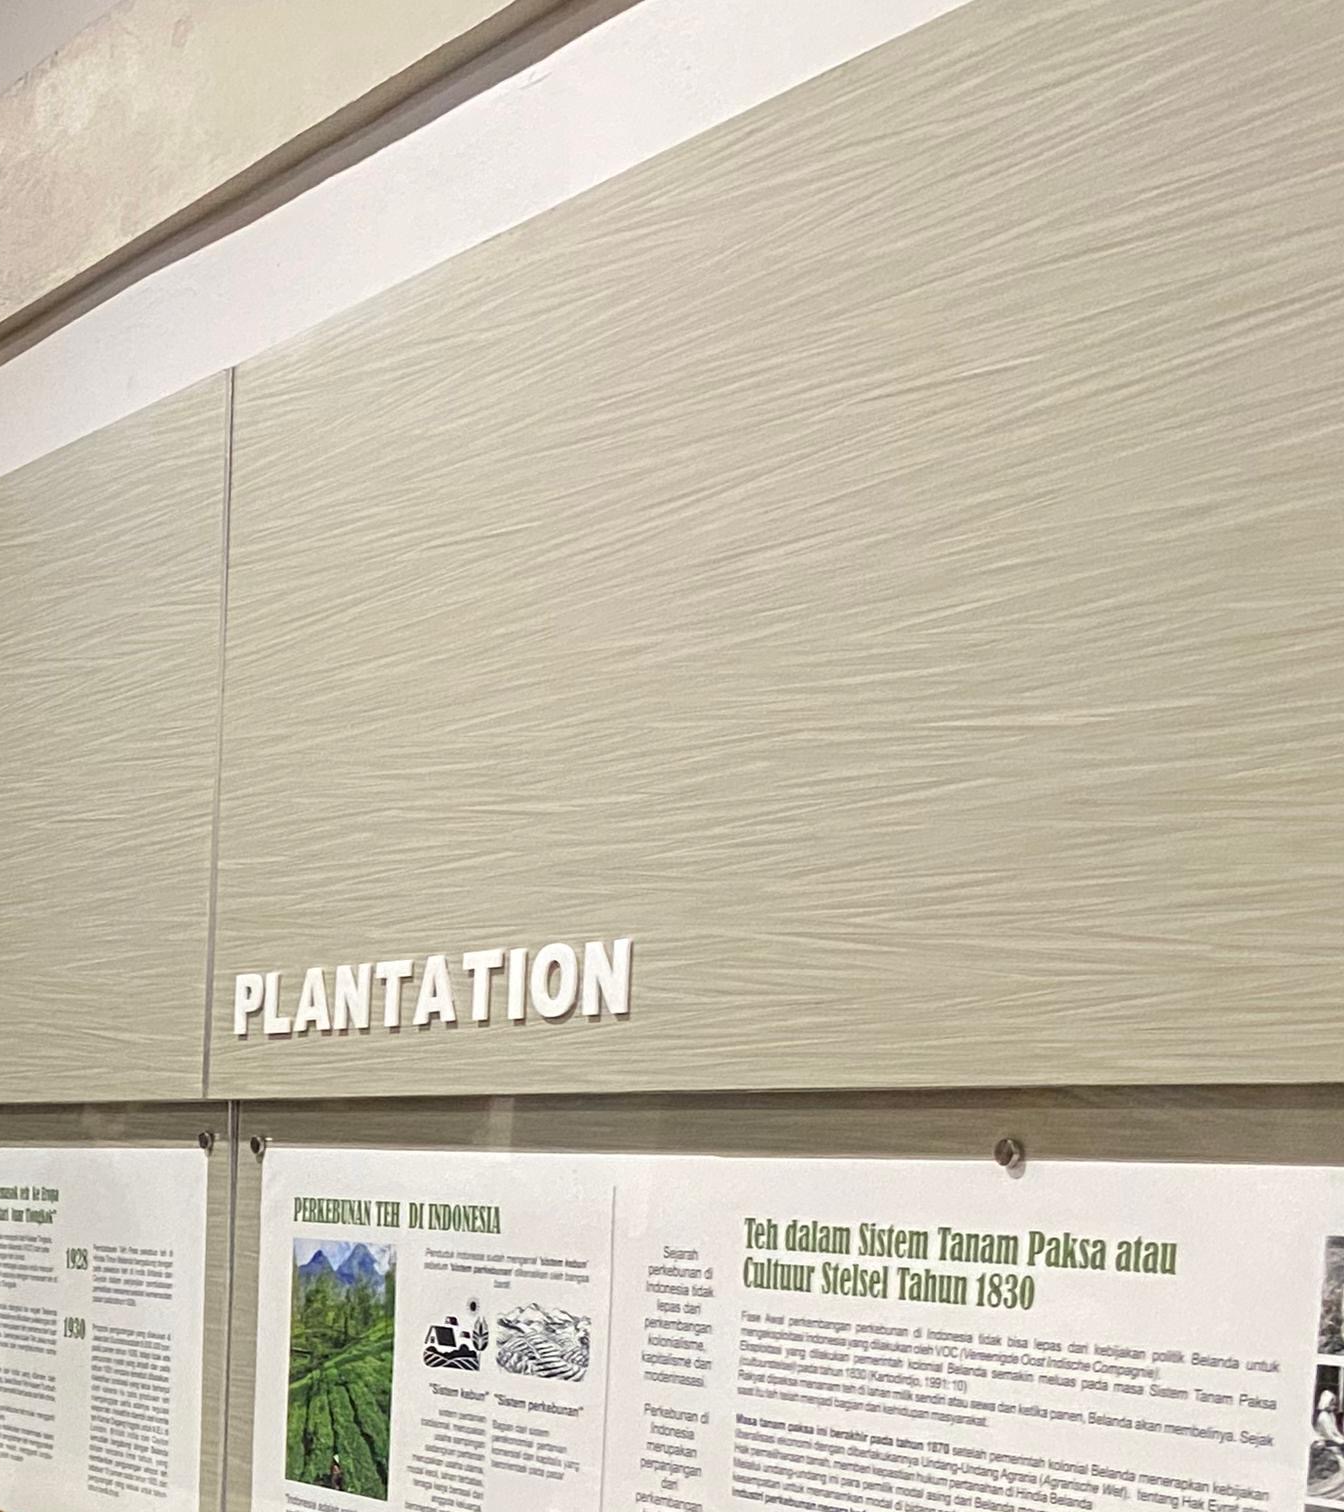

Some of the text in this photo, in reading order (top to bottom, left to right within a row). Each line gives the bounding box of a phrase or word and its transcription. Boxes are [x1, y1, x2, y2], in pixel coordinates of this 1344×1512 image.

[233, 938, 632, 1036] PLANTATION
[294, 1197, 501, 1234] PERKEBUNAN TEH DI INDONESIA
[744, 1217, 1178, 1275] Teh dalam Sistem Tanam Paksa atau
[704, 1267, 713, 1280] di
[743, 1257, 1035, 1311] Cultuur Stelsel Tahun 1830
[926, 1327, 972, 1342] Indonesia
[1007, 1335, 1028, 1348] bisa
[1190, 1352, 1238, 1367] Belanda
[1245, 1359, 1279, 1371] untuk
[934, 1345, 957, 1357] VOC
[1038, 1374, 1075, 1387] meluas
[1080, 1378, 1108, 1391] pada
[1113, 1383, 1143, 1394] masa
[1148, 1384, 1188, 1399] Sistem
[1194, 1389, 1232, 1404] Tanam
[1239, 1394, 1276, 1408] Paksa
[650, 1422, 695, 1440] Indonesia
[701, 1411, 709, 1424] di
[1087, 1411, 1132, 1428] Belanda
[1135, 1418, 1162, 1431] akan
[1164, 1423, 1236, 1442] membelinya.
[1240, 1430, 1273, 1446] Sejak
[1048, 1458, 1088, 1474] kolonial
[1091, 1464, 1136, 1481] Belanda
[1138, 1474, 1209, 1491] menerapkan
[1212, 1482, 1270, 1500] kebijakan
[1136, 1490, 1179, 1508] tentang
[1182, 1496, 1204, 1509] Hak
